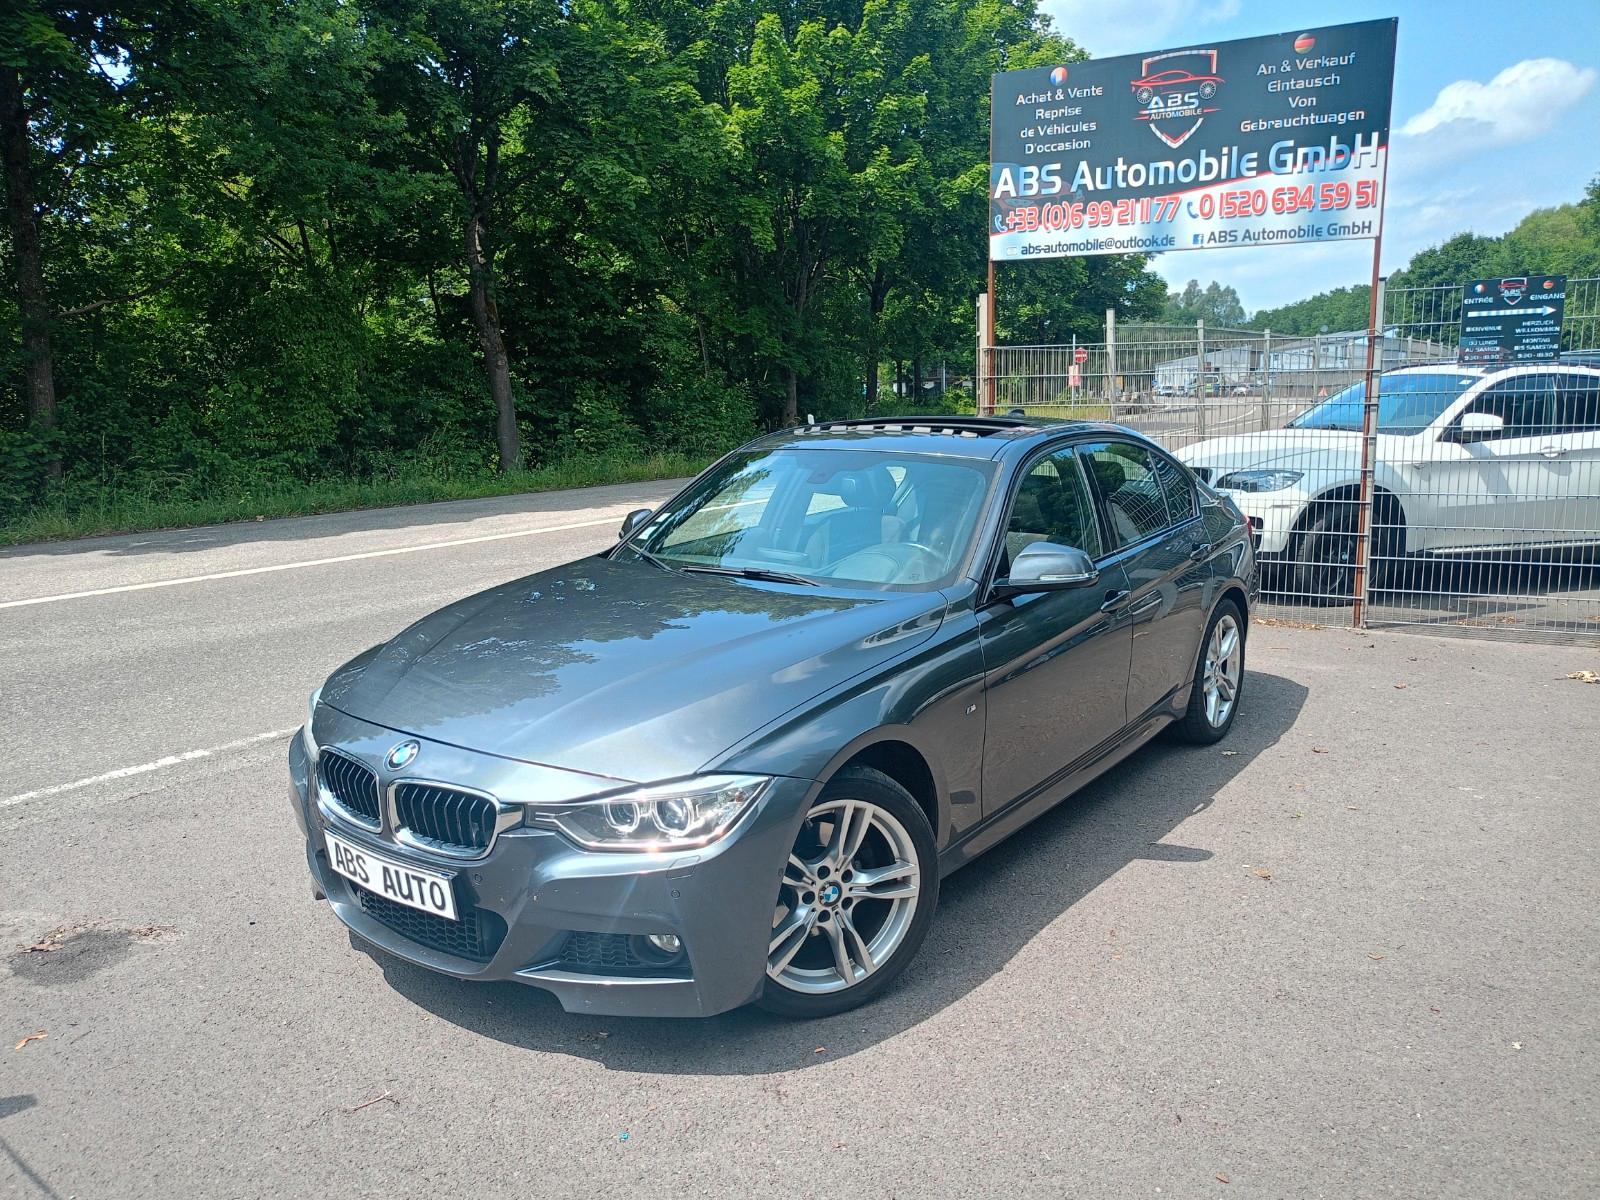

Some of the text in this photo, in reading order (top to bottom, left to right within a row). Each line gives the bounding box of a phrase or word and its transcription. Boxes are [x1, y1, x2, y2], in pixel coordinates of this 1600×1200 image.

[1256, 52, 1356, 76] An & Verkauf
[1267, 74, 1341, 92] Eintausch
[1015, 85, 1103, 105] Achat & Vente
[1147, 92, 1199, 109] ABS
[1288, 96, 1316, 108] Von
[1035, 106, 1083, 120] Reprise
[1149, 108, 1202, 120] AUTOMOBILE
[1240, 110, 1365, 132] Gebrauchtwagen
[1020, 121, 1097, 138] de Véhicules
[1025, 139, 1091, 154] D'occasion
[993, 131, 1379, 199] ABS Automobile GmbH
[1271, 184, 1315, 215] 634
[1319, 182, 1351, 210] 59
[1355, 179, 1379, 208] 51
[1006, 206, 1039, 232] +33
[1087, 200, 1114, 227] 99
[1117, 199, 1135, 225] 21
[1154, 196, 1182, 222] 77
[1207, 221, 1372, 244] ABS Automobile GmbH
[1021, 234, 1175, 255] abs-automobile@outlook.de
[1464, 296, 1494, 305] ENTRÉE
[1530, 293, 1566, 301] EINGANG
[334, 841, 447, 911] ABS AUTO
